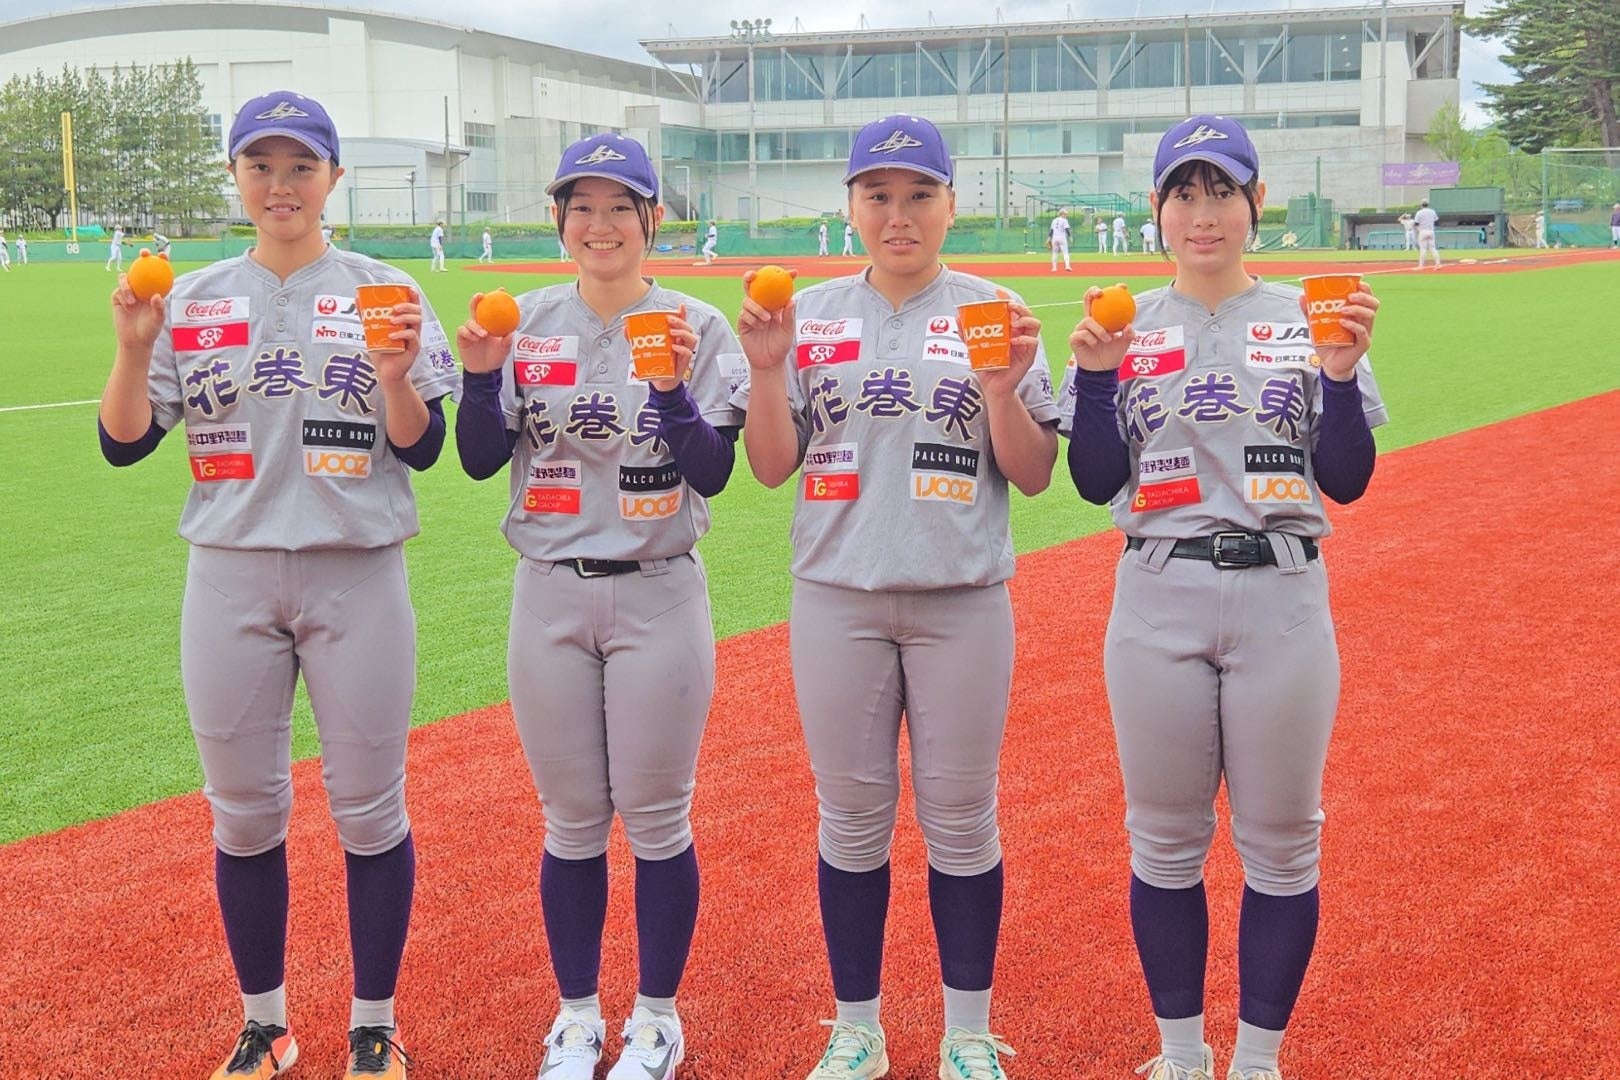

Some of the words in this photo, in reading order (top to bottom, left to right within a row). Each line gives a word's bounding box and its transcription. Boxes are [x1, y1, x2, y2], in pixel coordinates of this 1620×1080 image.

[66, 243, 80, 254] 98
[1276, 327, 1309, 340] JA
[184, 347, 378, 416] 花巻東
[810, 367, 983, 442] 花巻東
[1127, 371, 1306, 443] 花巻東
[304, 427, 342, 439] PALCO
[349, 430, 374, 442] HOME
[915, 450, 950, 463] PALCO
[955, 455, 976, 469] HOME
[1247, 453, 1285, 464] PALCO
[620, 473, 654, 484] PALCO
